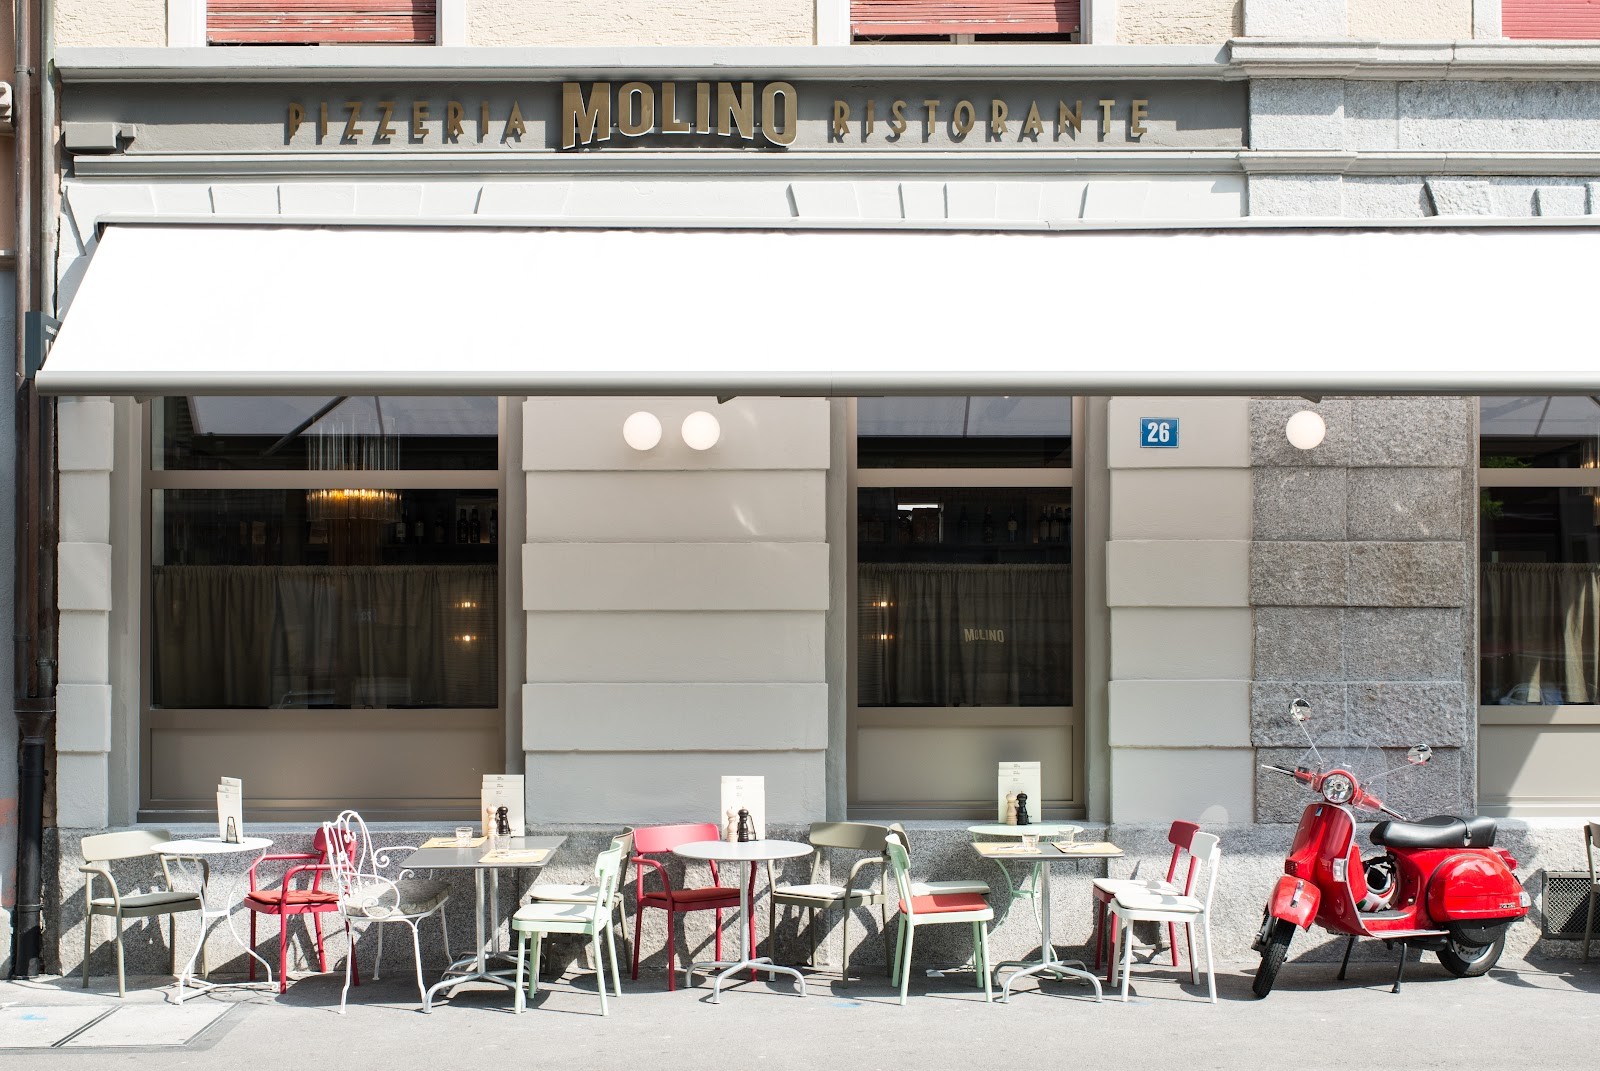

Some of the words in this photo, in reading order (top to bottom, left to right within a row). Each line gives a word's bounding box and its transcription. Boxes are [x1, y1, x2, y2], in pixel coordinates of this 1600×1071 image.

[288, 101, 527, 136] PIZZERIA
[563, 82, 797, 149] MOLINO
[833, 99, 1149, 135] RISTORANTE
[1147, 422, 1170, 443] 26
[964, 628, 1005, 643] MOLINO
